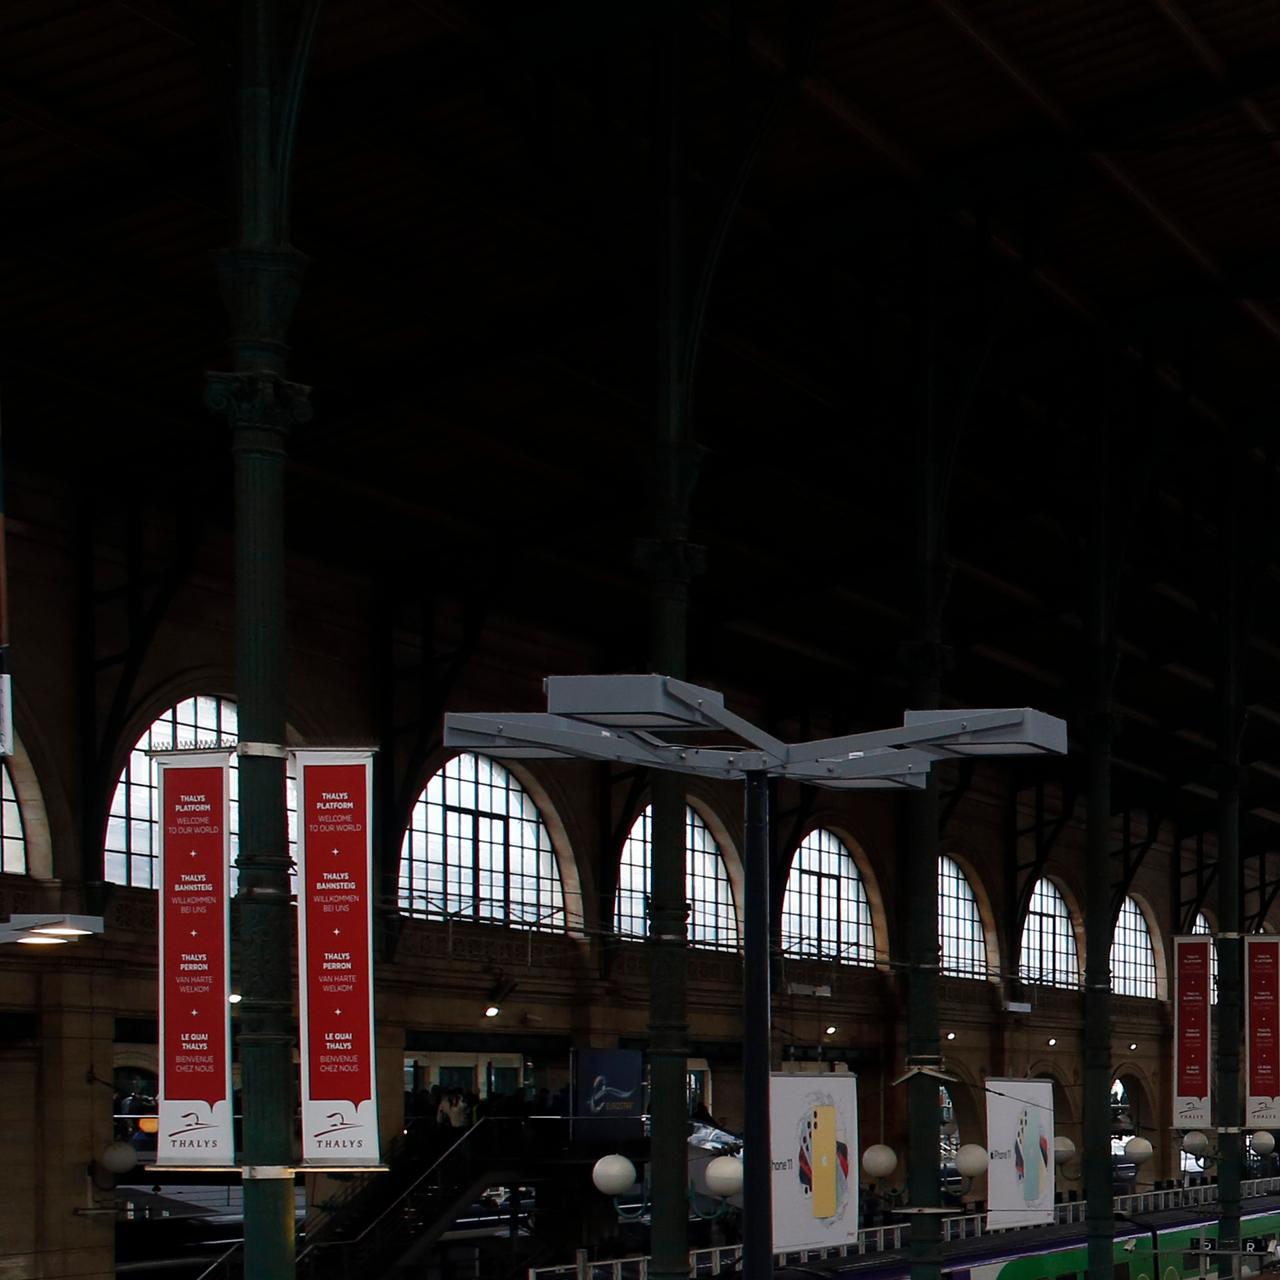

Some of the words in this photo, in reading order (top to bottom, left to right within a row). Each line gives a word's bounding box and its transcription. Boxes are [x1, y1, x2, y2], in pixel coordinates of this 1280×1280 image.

[180, 794, 206, 802] THALYS
[322, 792, 348, 800] THALYS
[175, 804, 211, 812] PLATFORM
[316, 801, 354, 810] PLATFORM
[176, 816, 209, 825] WELCOME
[318, 814, 352, 823] WELCOME
[168, 826, 178, 834] TO
[178, 826, 192, 834] OUR
[193, 826, 219, 834] WORLD
[309, 824, 319, 832] TO
[320, 824, 333, 832] OUR
[335, 824, 362, 832] WORLD
[180, 874, 206, 882] THALYS
[322, 872, 349, 880] THALYS
[174, 883, 213, 892] BAHNSTEIG
[316, 882, 356, 890] BAHNSTEIG
[171, 896, 216, 904] WILLKOMMEN
[313, 895, 360, 903] WILLKOMMEN
[180, 906, 192, 914] BEI
[192, 906, 207, 914] UNS
[323, 904, 335, 912] BEI
[335, 904, 350, 912] UNS
[181, 954, 207, 962] THALYS
[324, 952, 350, 960] THALYS
[180, 963, 208, 971] PERRON
[323, 962, 352, 970] PERRON
[175, 976, 190, 984] VAN
[190, 976, 213, 984] HARTE
[318, 975, 333, 983] VAN
[333, 975, 357, 983] HARTE
[180, 985, 210, 993] WELKOM
[322, 984, 353, 992] WELKOM
[180, 1033, 190, 1041] LE
[190, 1033, 208, 1041] QUAI
[324, 1032, 334, 1040] LE
[334, 1032, 352, 1040] QUAI
[181, 1042, 208, 1050] THALYS
[326, 1042, 352, 1050] THALYS
[175, 1055, 214, 1064] BIENVENUE
[320, 1055, 358, 1063] BIENVENUE
[175, 1064, 194, 1073] CHEZ
[194, 1064, 215, 1073] NOUS
[320, 1064, 338, 1072] CHEZ
[338, 1064, 359, 1072] NOUS
[171, 1140, 218, 1148] THALYS
[316, 1140, 363, 1148] THALYS
[1246, 1242, 1255, 1253] R
